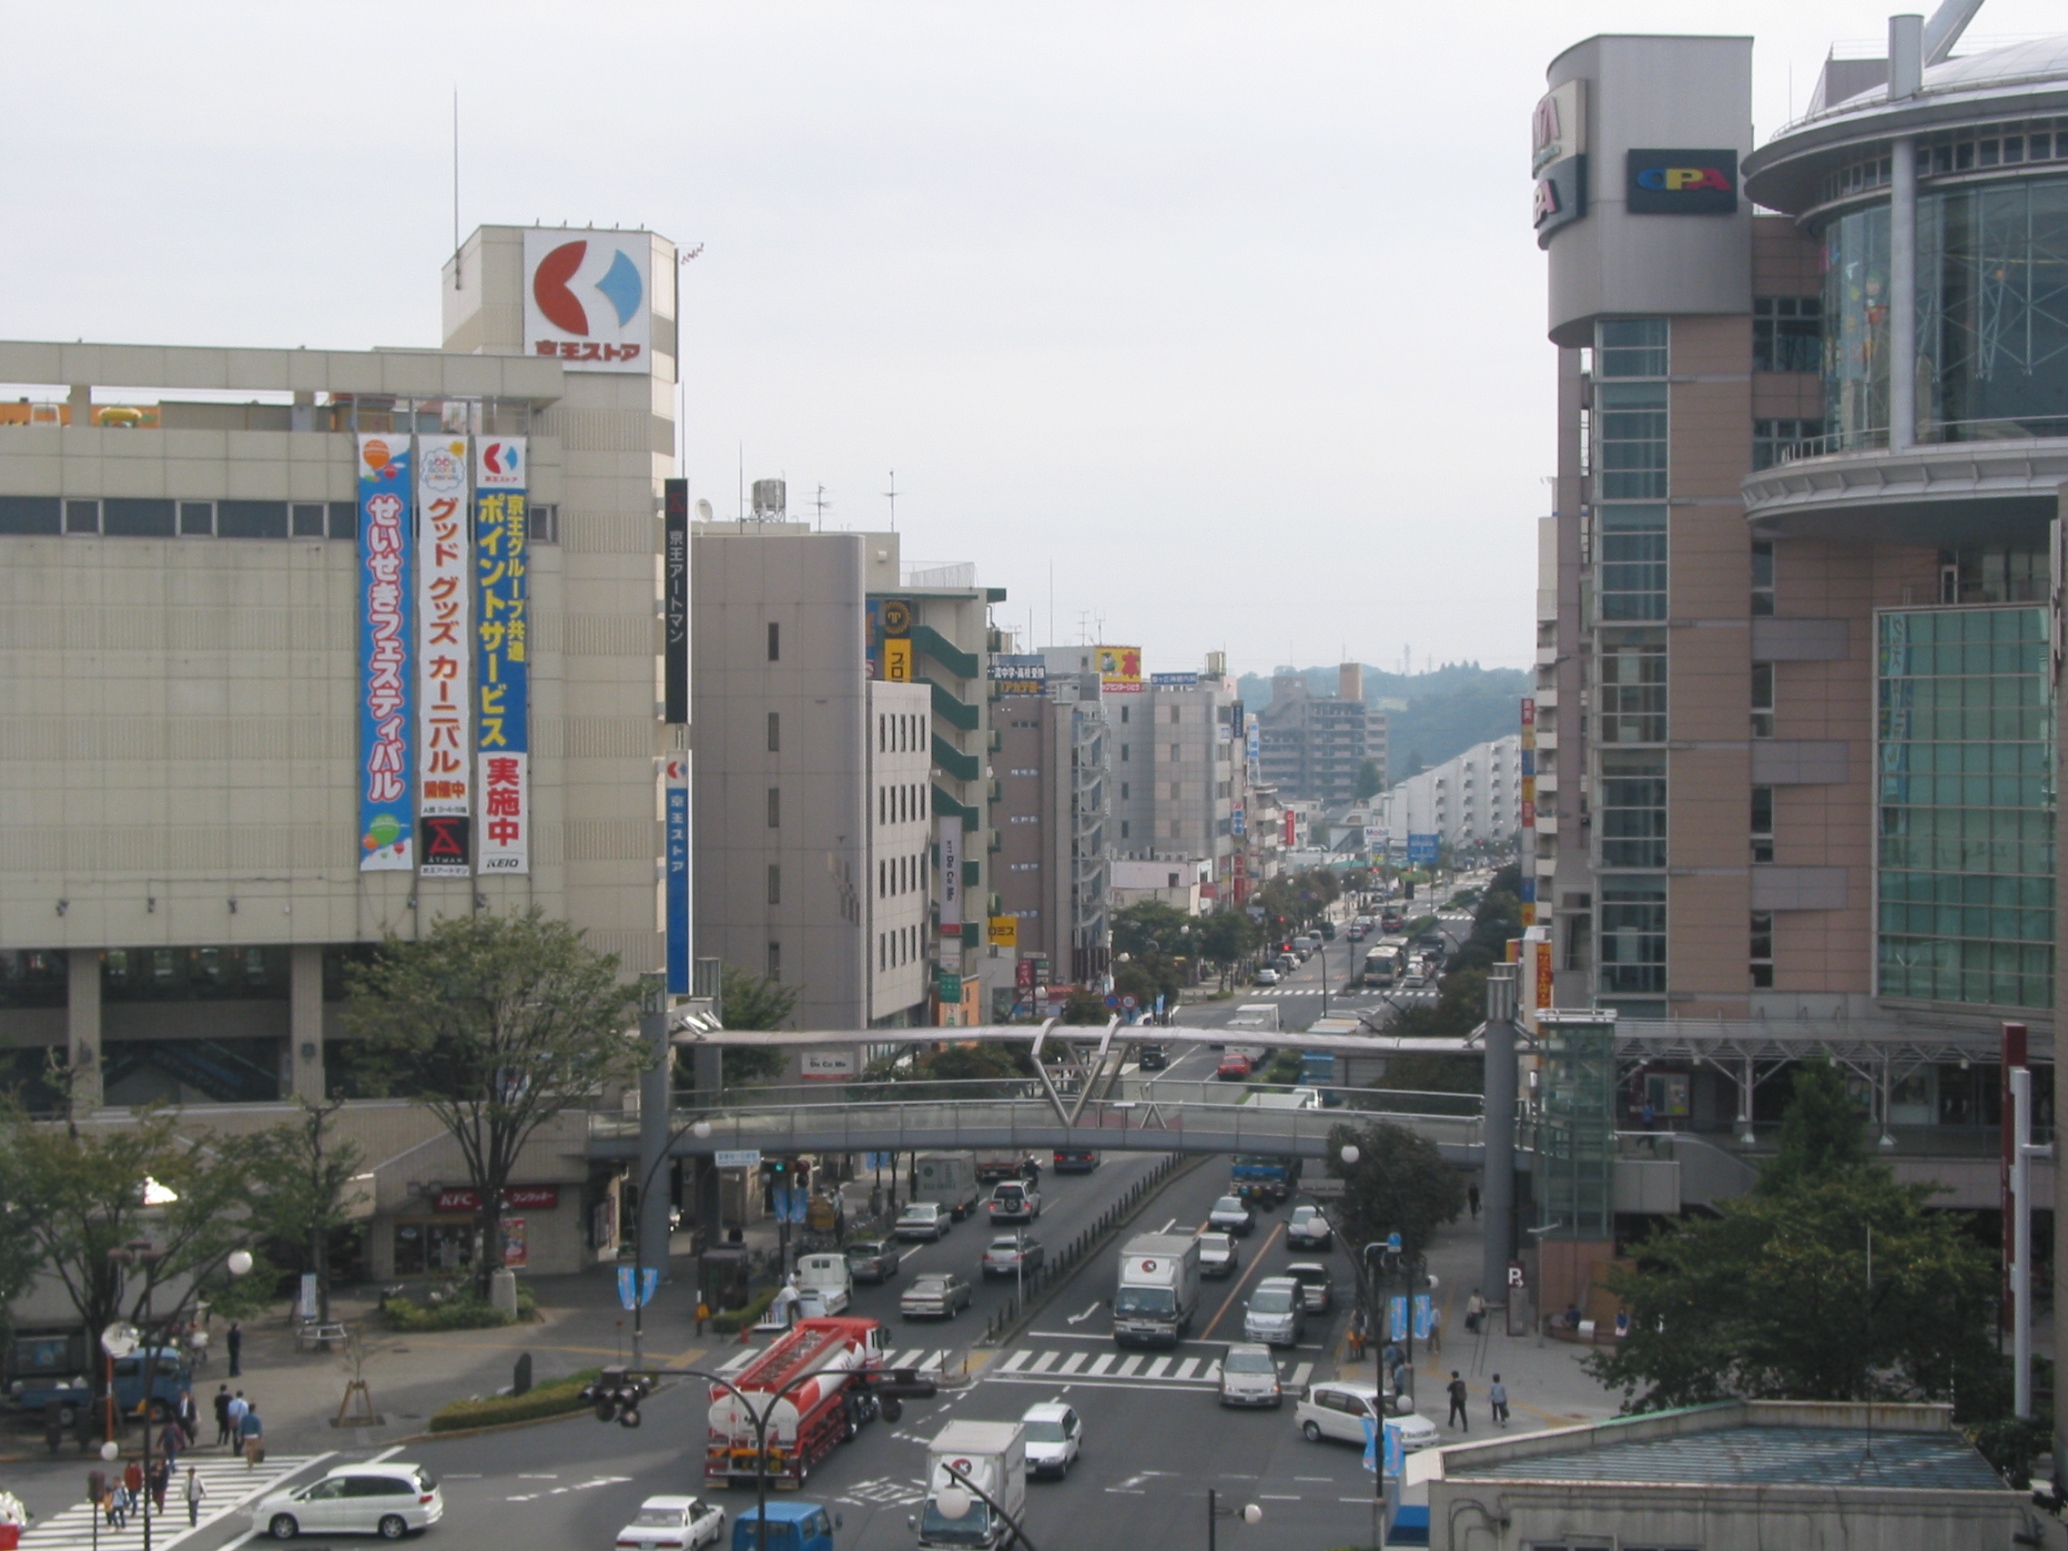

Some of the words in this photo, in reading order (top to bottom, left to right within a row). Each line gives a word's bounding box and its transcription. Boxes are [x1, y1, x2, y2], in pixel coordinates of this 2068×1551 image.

[1636, 167, 1732, 190] OPA
[535, 339, 640, 362] 京王ストア
[507, 494, 526, 662] 京王グループ共通
[669, 529, 684, 644] 京王アートマン
[479, 493, 507, 747] ポイントサービス
[367, 494, 405, 802] せいせきフェスティバル
[891, 652, 904, 683] プロ
[1001, 680, 1045, 694] アカデミー
[487, 757, 520, 847] 実施中
[670, 795, 684, 873] 京王ストア
[1366, 828, 1389, 836] Mobil
[487, 858, 518, 868] KEIO
[441, 1193, 472, 1206] KFC
[1508, 1267, 1522, 1285] P
